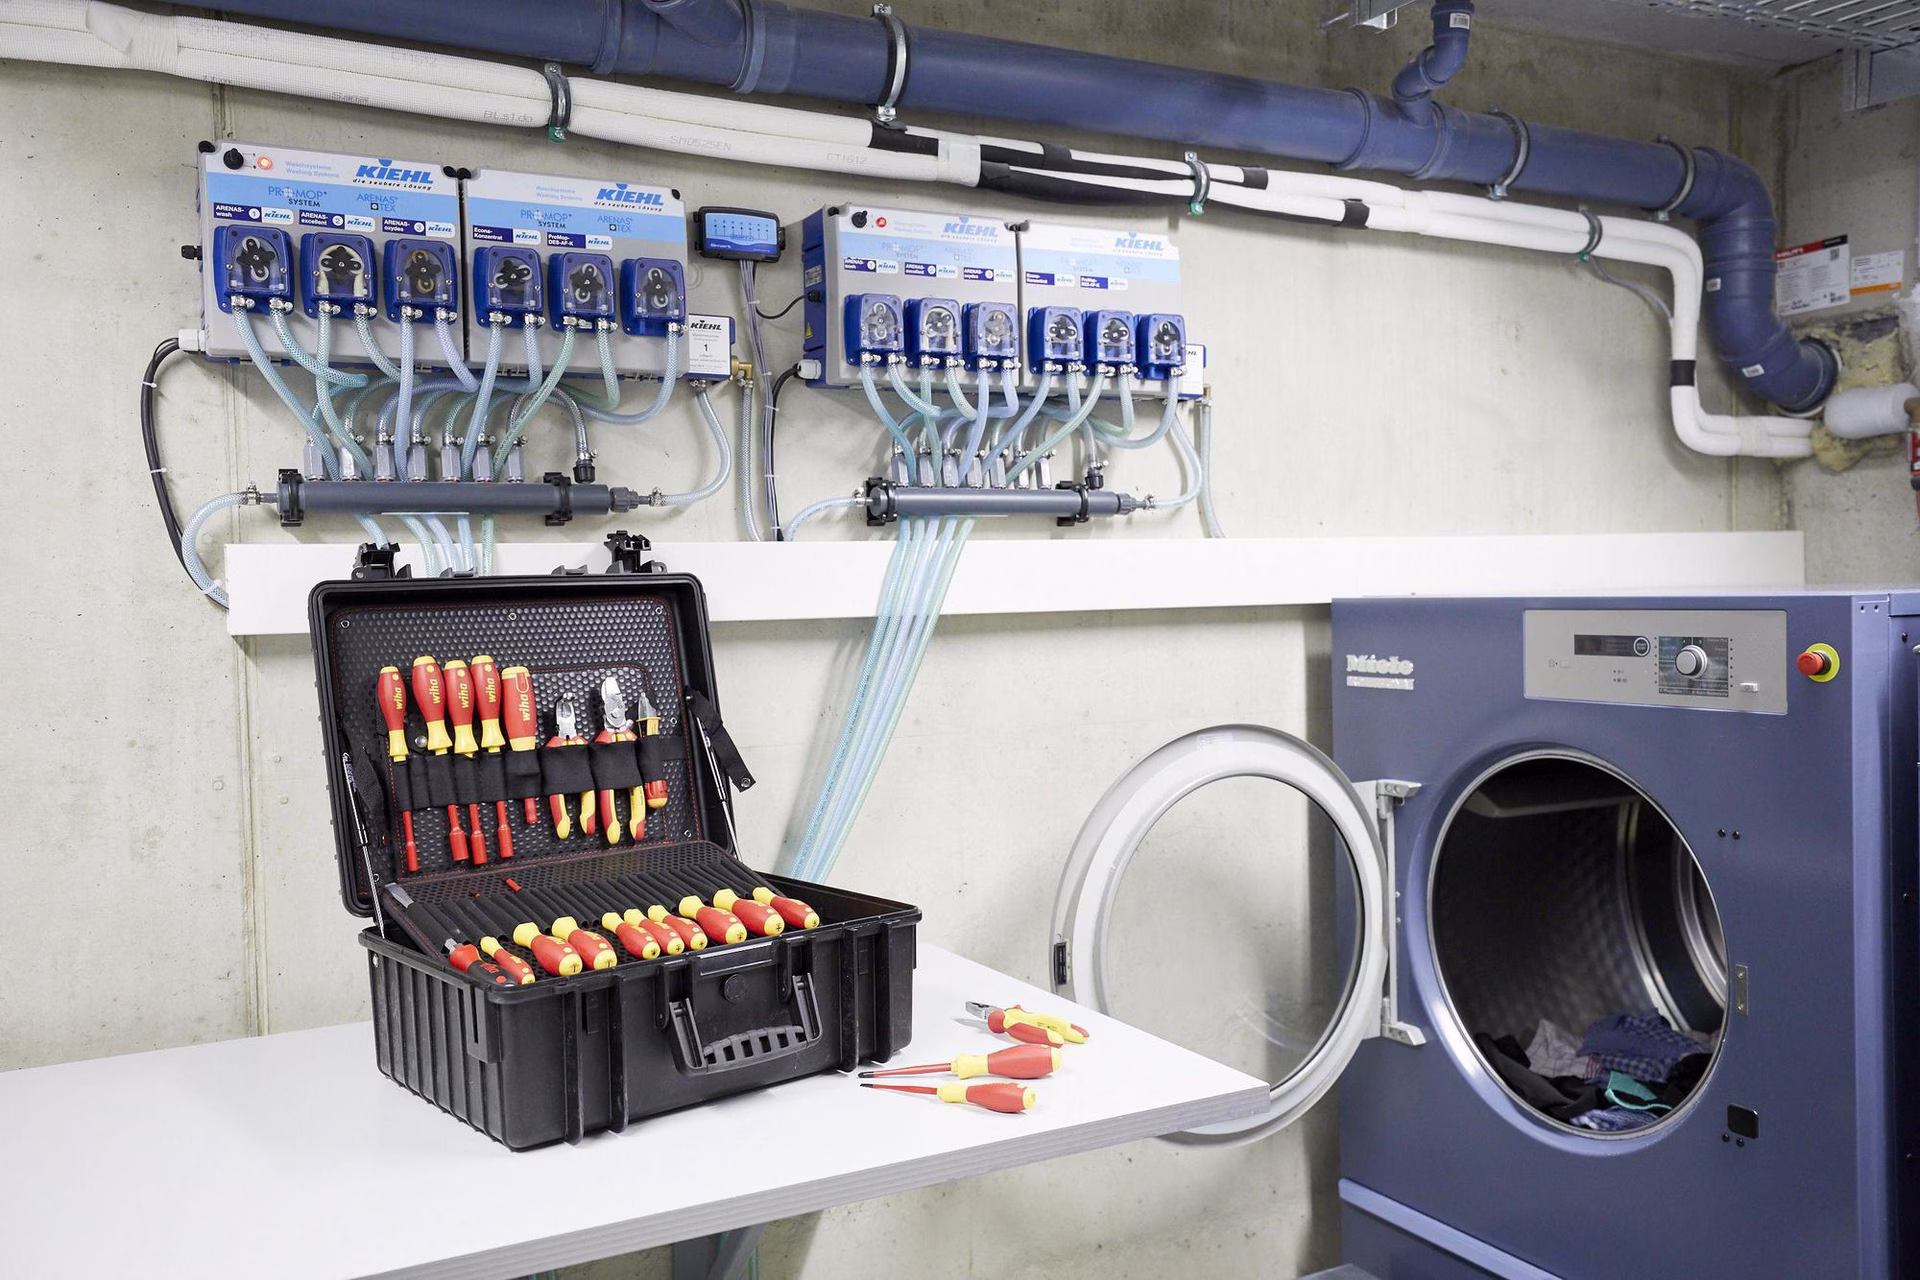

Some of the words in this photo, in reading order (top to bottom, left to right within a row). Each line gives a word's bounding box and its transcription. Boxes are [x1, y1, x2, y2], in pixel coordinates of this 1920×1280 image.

[356, 159, 434, 184] KIEHL
[597, 183, 664, 206] KIEHL
[215, 204, 244, 212] ARENAS-
[288, 198, 320, 208] SYSTEM
[264, 210, 292, 220] KIEHL
[300, 212, 328, 220] ARENAS-
[300, 218, 328, 226] excellent
[347, 218, 372, 227] KIEHL
[538, 220, 566, 230] SYSTEM
[943, 215, 998, 237] KIEHL
[428, 224, 453, 233] KIEHL
[515, 232, 538, 240] KIEHL
[588, 238, 610, 246] KIEHL
[1114, 232, 1164, 251] KIEHL
[690, 320, 722, 330] KIEHL
[1346, 654, 1414, 676] Miele
[428, 678, 440, 704] wiha
[485, 677, 497, 703] wiha
[393, 687, 403, 710] wiha
[458, 683, 470, 709] wiha
[518, 693, 530, 722] wiha
